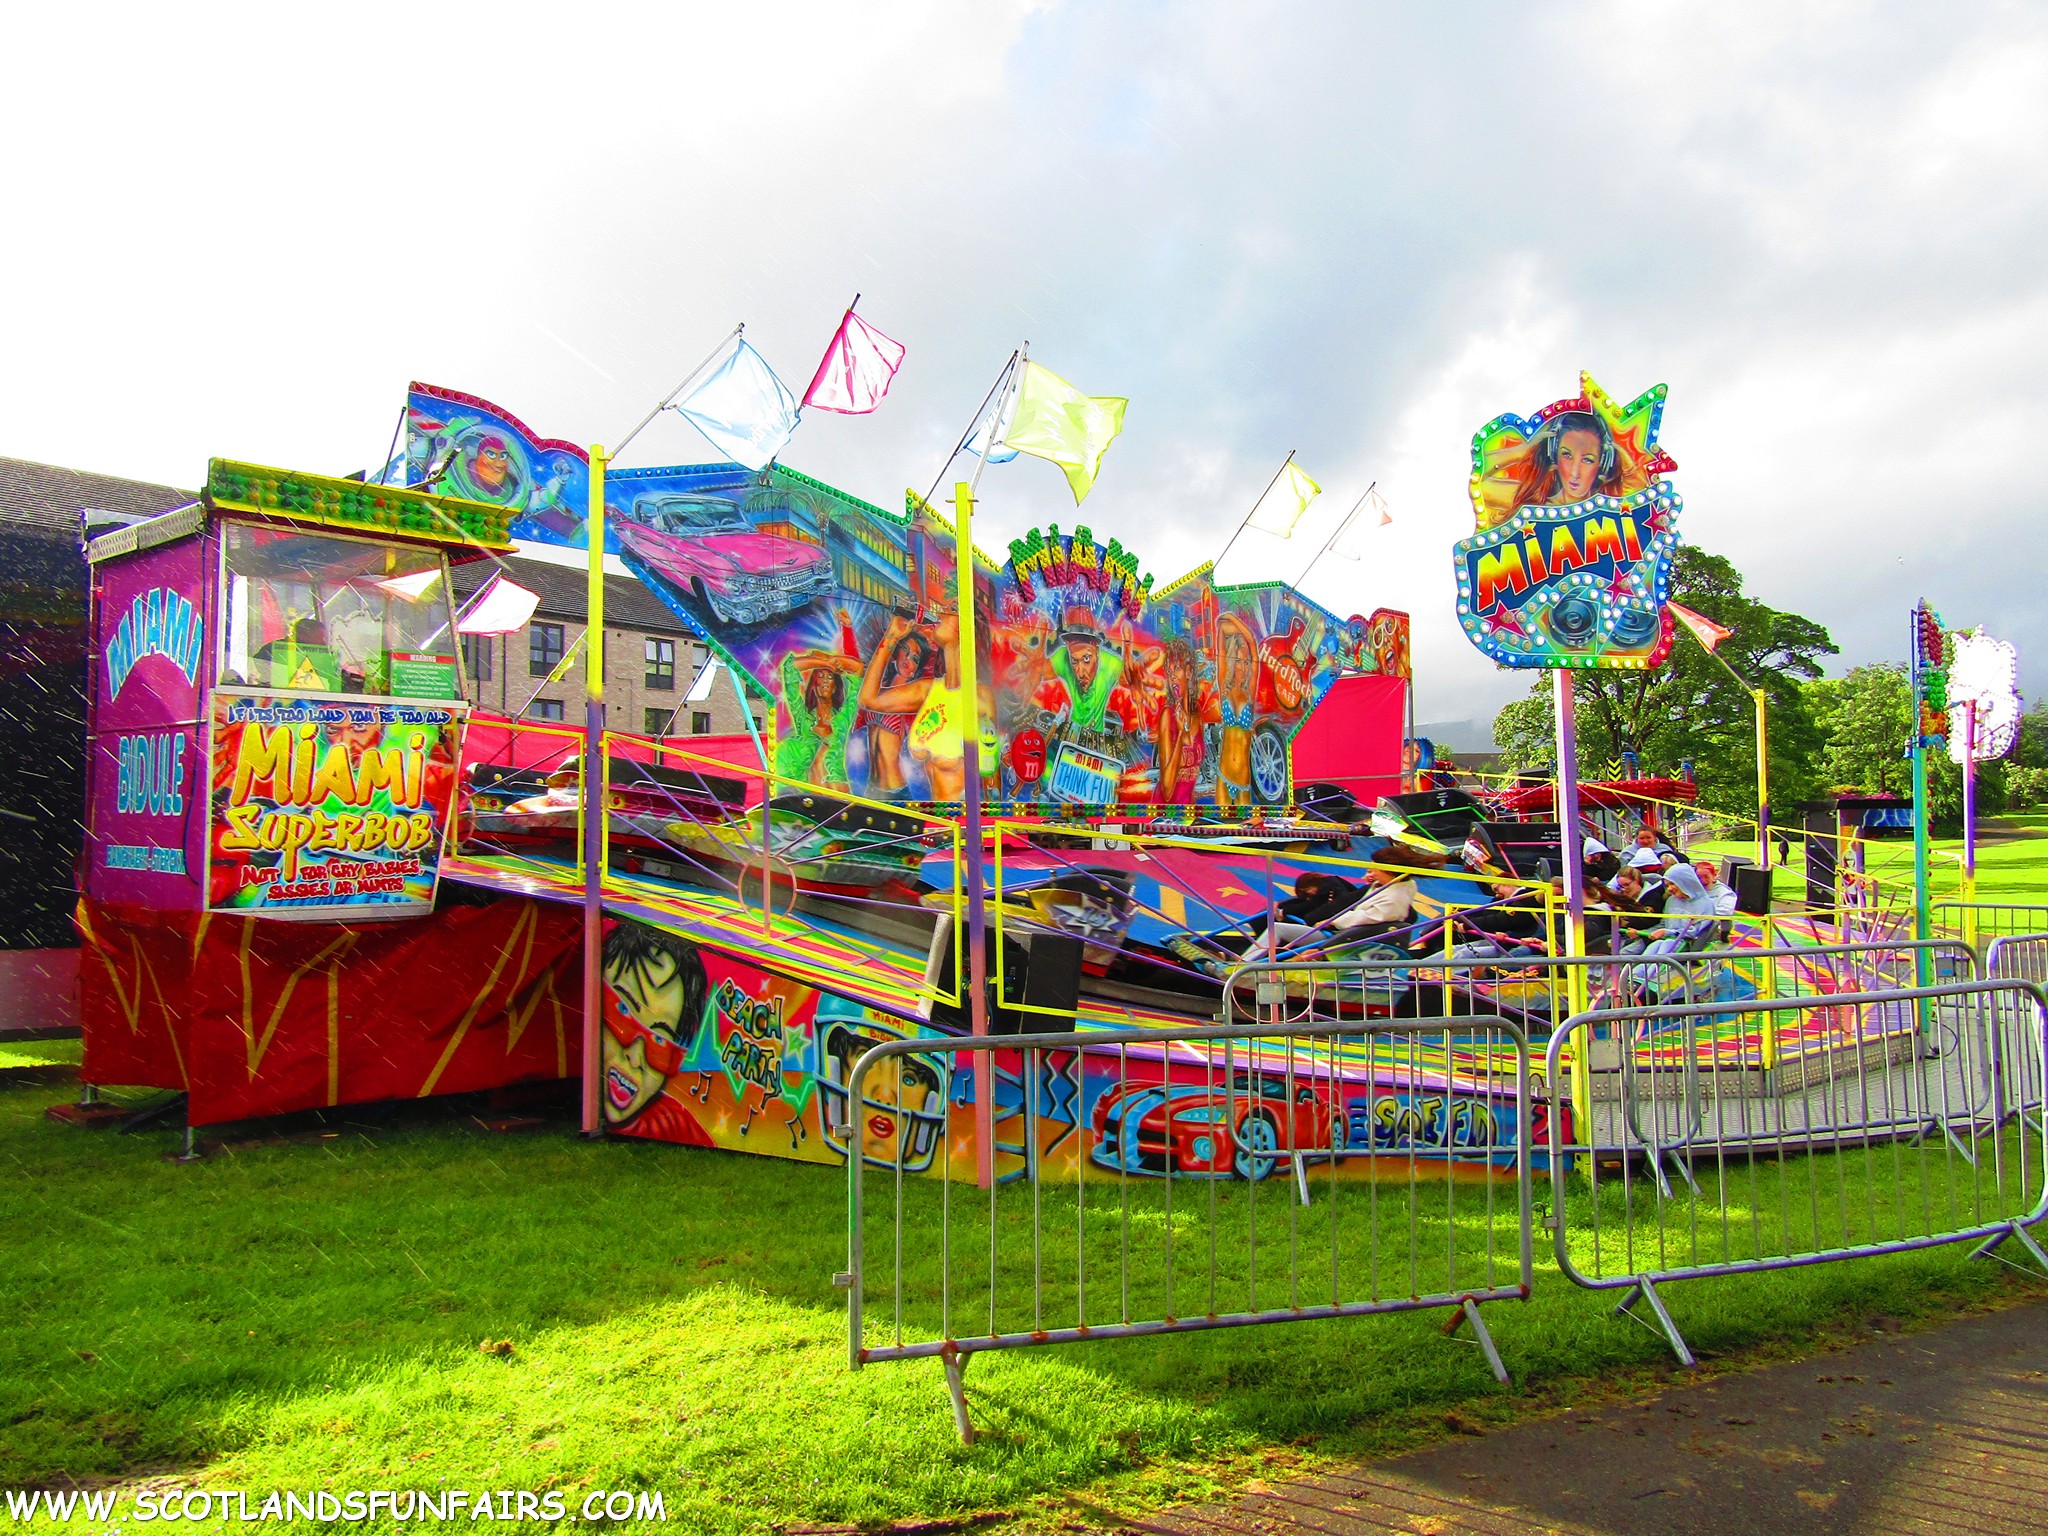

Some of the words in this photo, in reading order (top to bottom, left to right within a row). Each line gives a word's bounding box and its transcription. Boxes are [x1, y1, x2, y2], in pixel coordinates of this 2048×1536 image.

[1009, 523, 1154, 619] MIAMI
[106, 588, 203, 702] MIAMI
[1259, 643, 1290, 679] Hard
[1288, 667, 1312, 704] Rock
[227, 706, 247, 723] IF
[277, 708, 306, 723] TOO
[308, 710, 345, 723] LOUD
[349, 706, 395, 724] YOU'RE
[399, 709, 427, 724] TOO
[426, 710, 452, 725] OLD
[117, 733, 185, 816] BIDULE
[1057, 761, 1090, 797] THINK
[1075, 753, 1103, 772] MIAMI
[240, 865, 280, 887] NOT
[300, 865, 329, 881] FOR
[327, 858, 359, 879] CRY
[334, 879, 355, 896] OR
[715, 977, 784, 1041] BEACH
[721, 1031, 783, 1111] PARTY
[1370, 1095, 1499, 1148] SPEED
